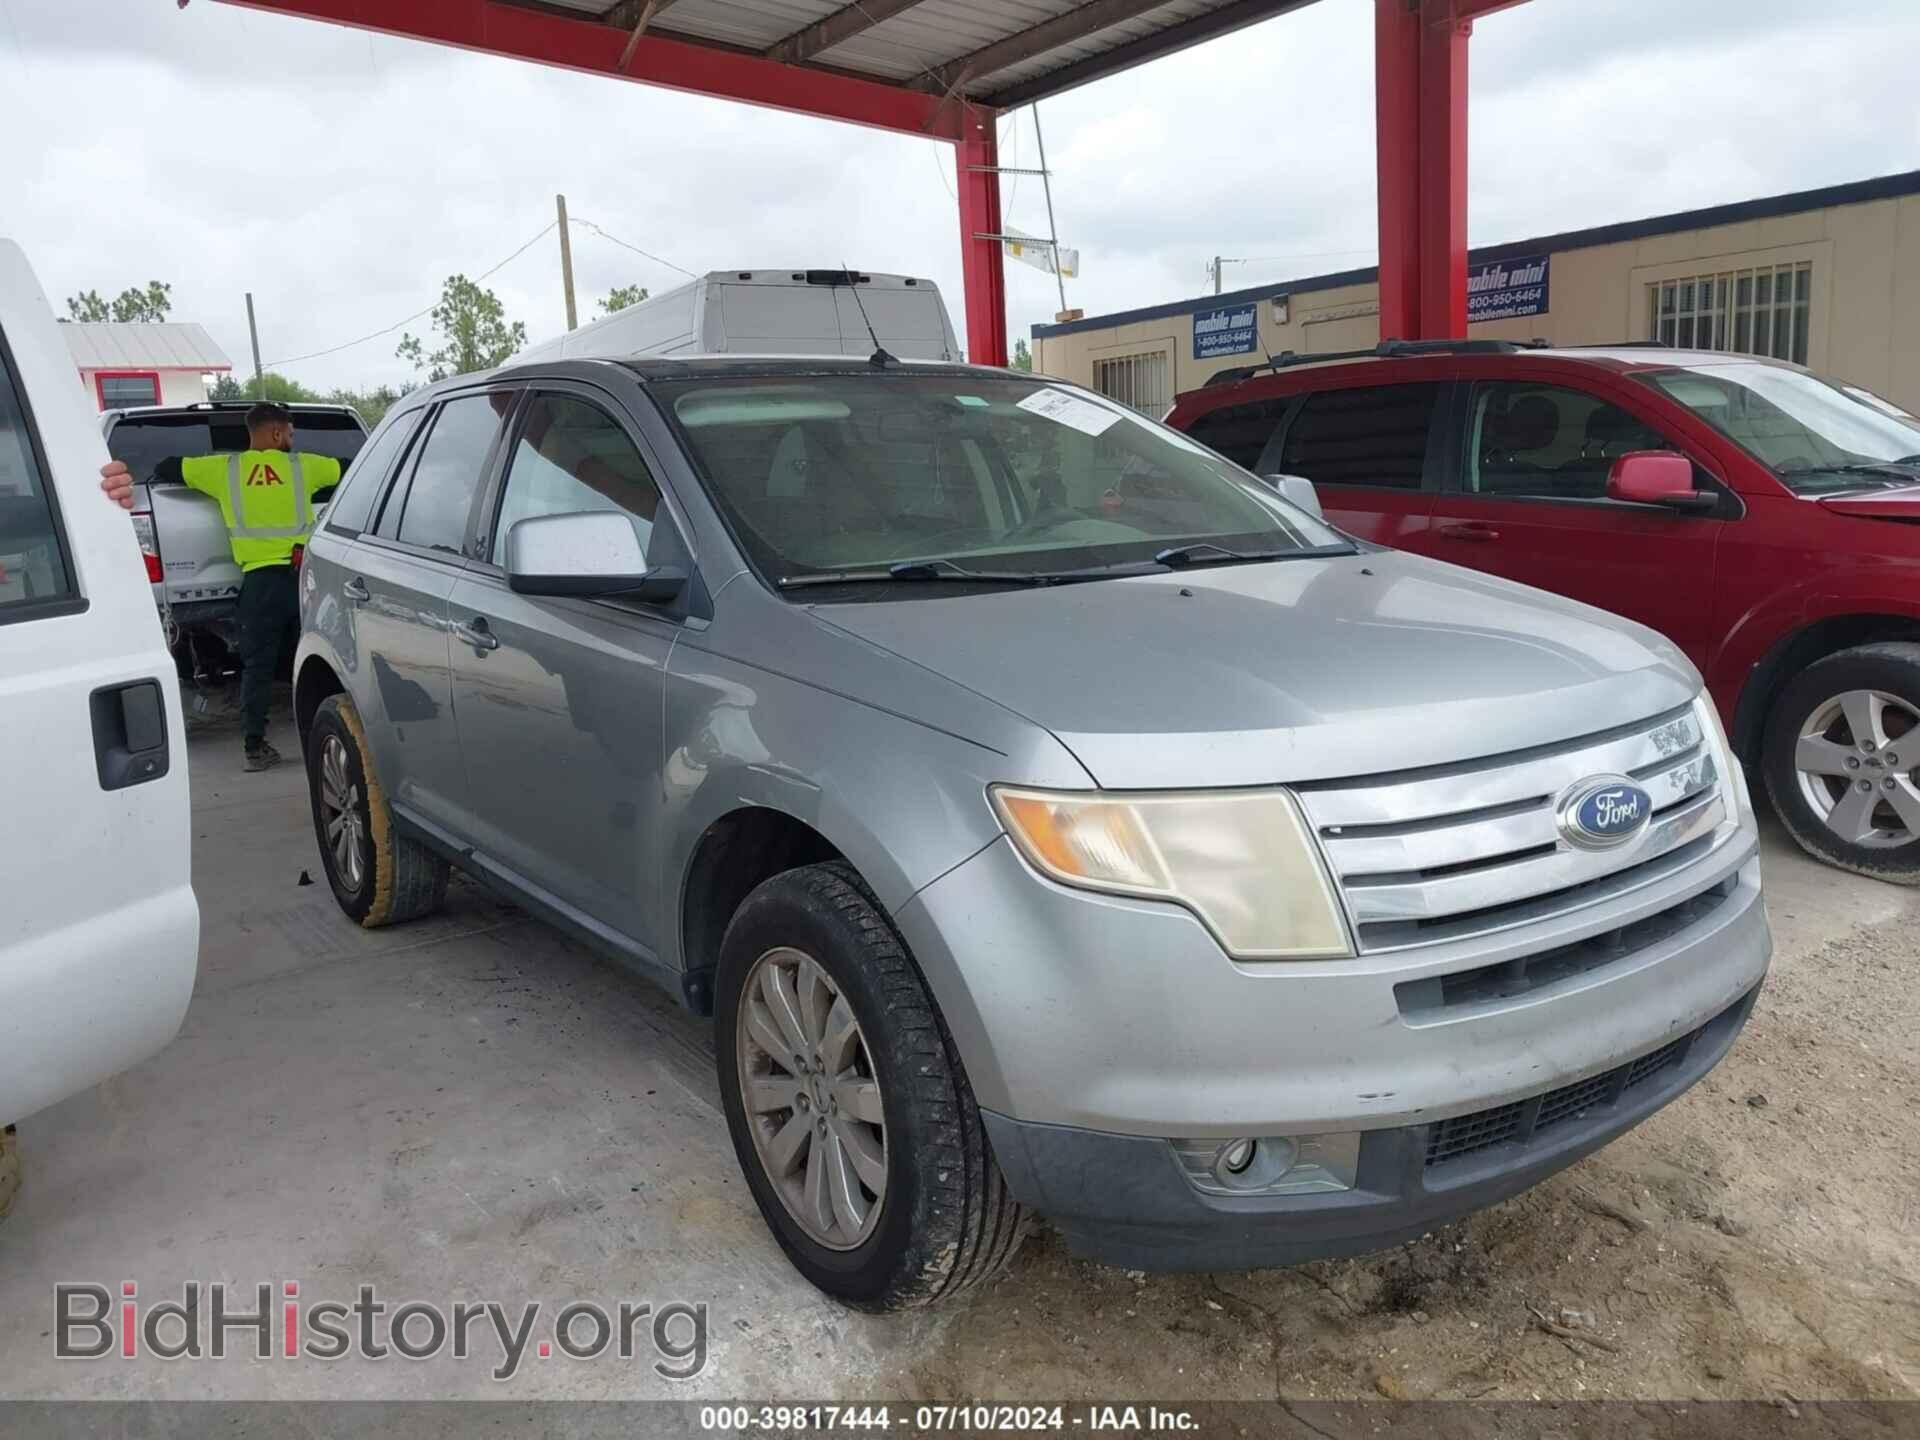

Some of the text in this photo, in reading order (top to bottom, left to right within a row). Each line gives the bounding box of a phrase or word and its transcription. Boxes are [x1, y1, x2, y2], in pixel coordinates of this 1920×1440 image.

[1509, 261, 1547, 287] mini
[1467, 288, 1542, 309] -800-950-6464
[1195, 309, 1255, 334] mobile mini
[173, 585, 240, 600] TITA
[1596, 791, 1640, 828] Ford
